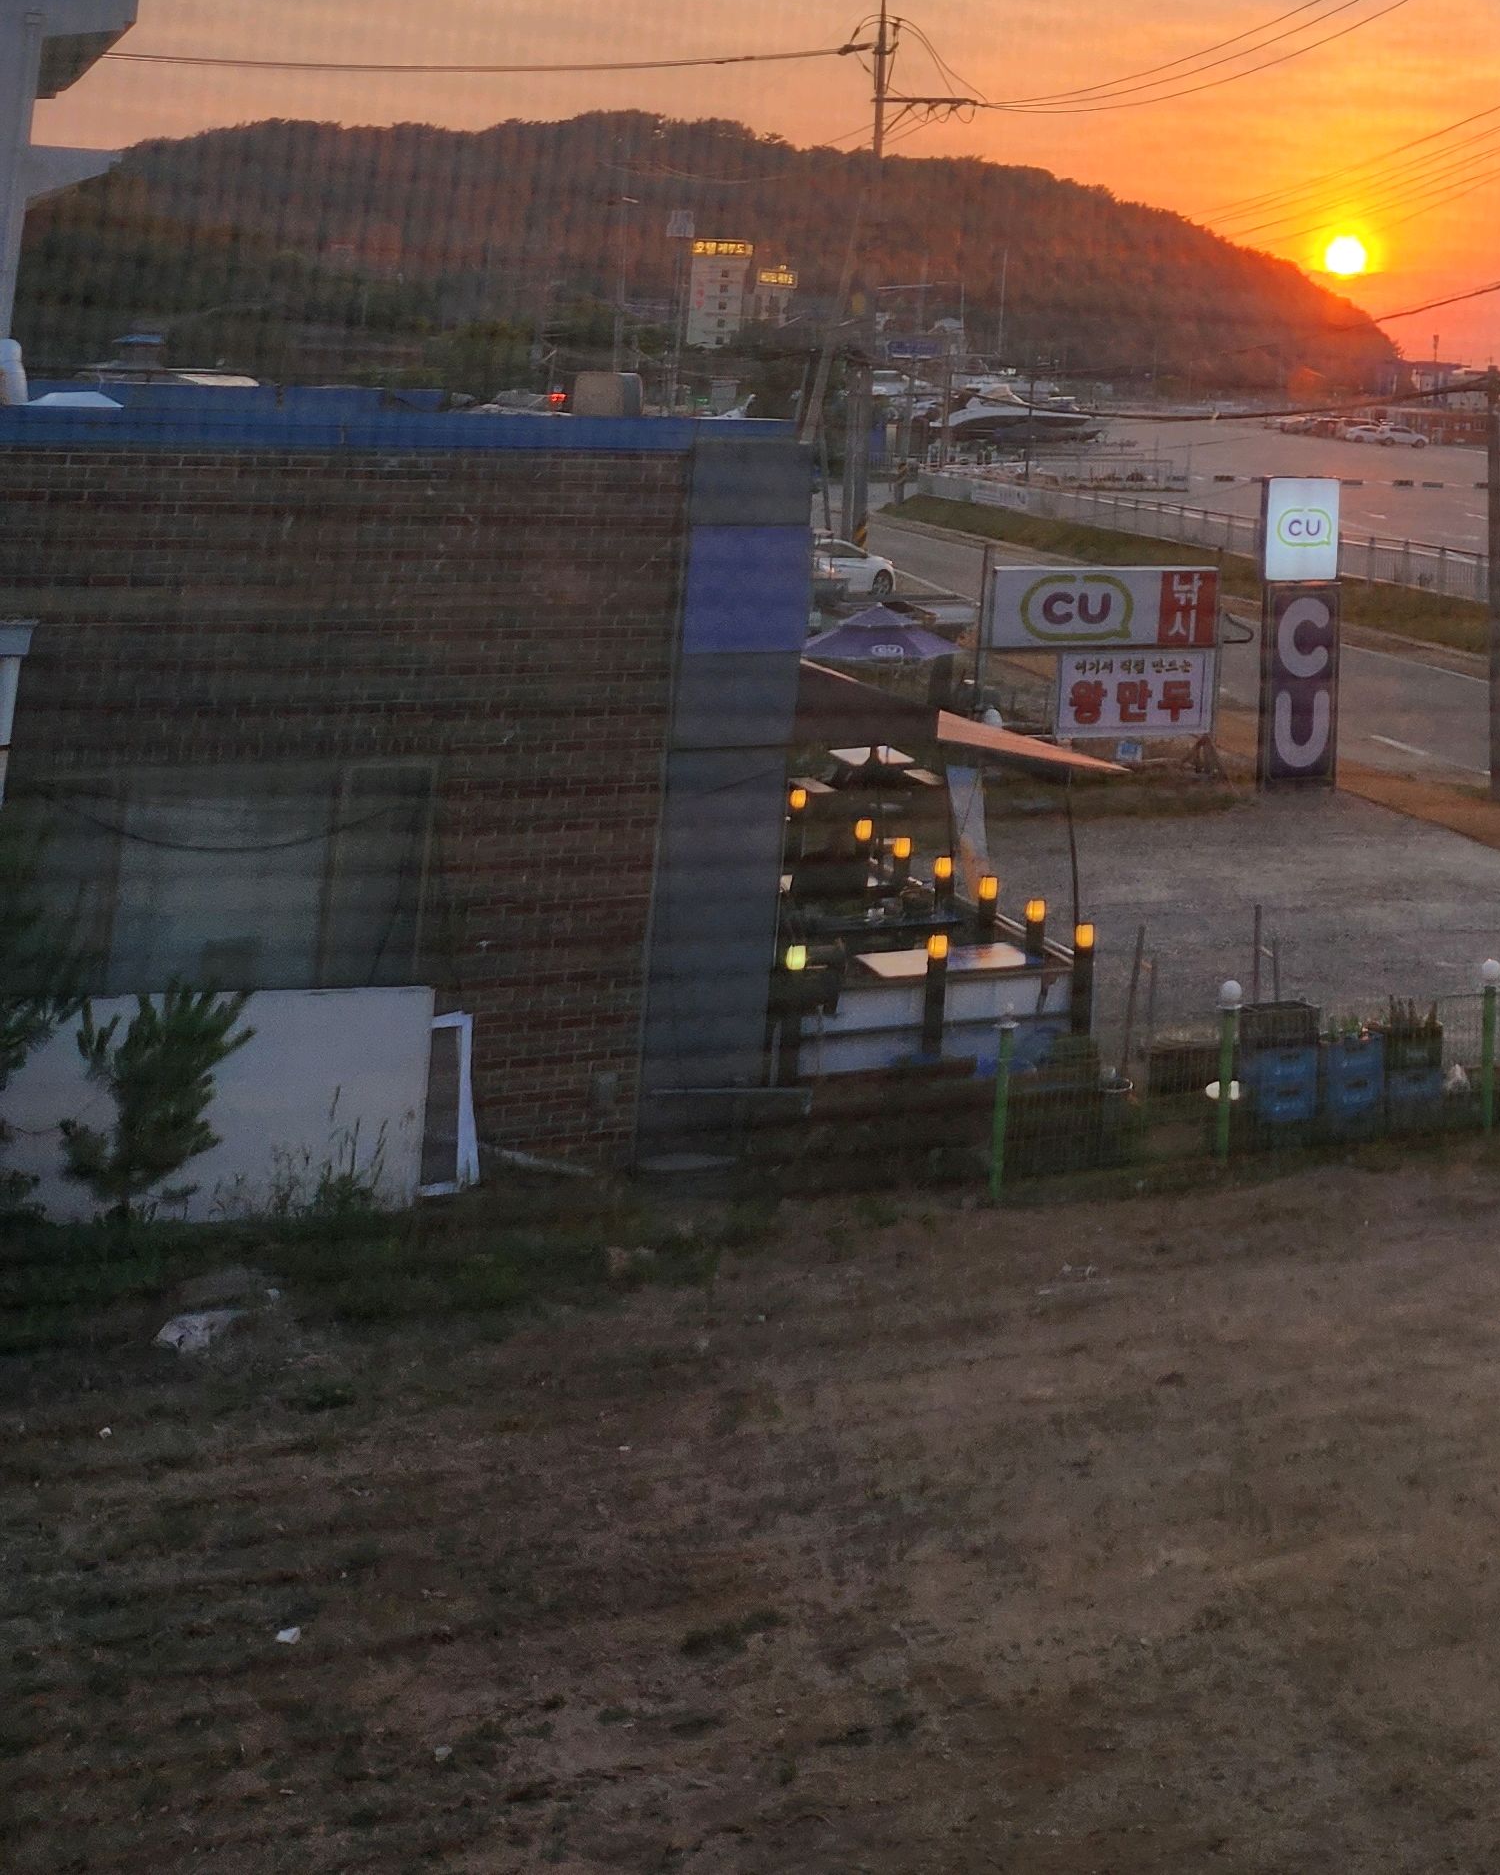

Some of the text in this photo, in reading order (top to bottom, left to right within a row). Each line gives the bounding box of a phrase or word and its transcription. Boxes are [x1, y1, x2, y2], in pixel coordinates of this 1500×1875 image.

[1288, 519, 1321, 537] CU
[1042, 591, 1111, 625] CU
[1170, 572, 1201, 644] 낚시
[1075, 657, 1193, 675] 여기서 직접 만드는
[1069, 679, 1195, 725] 왕만두
